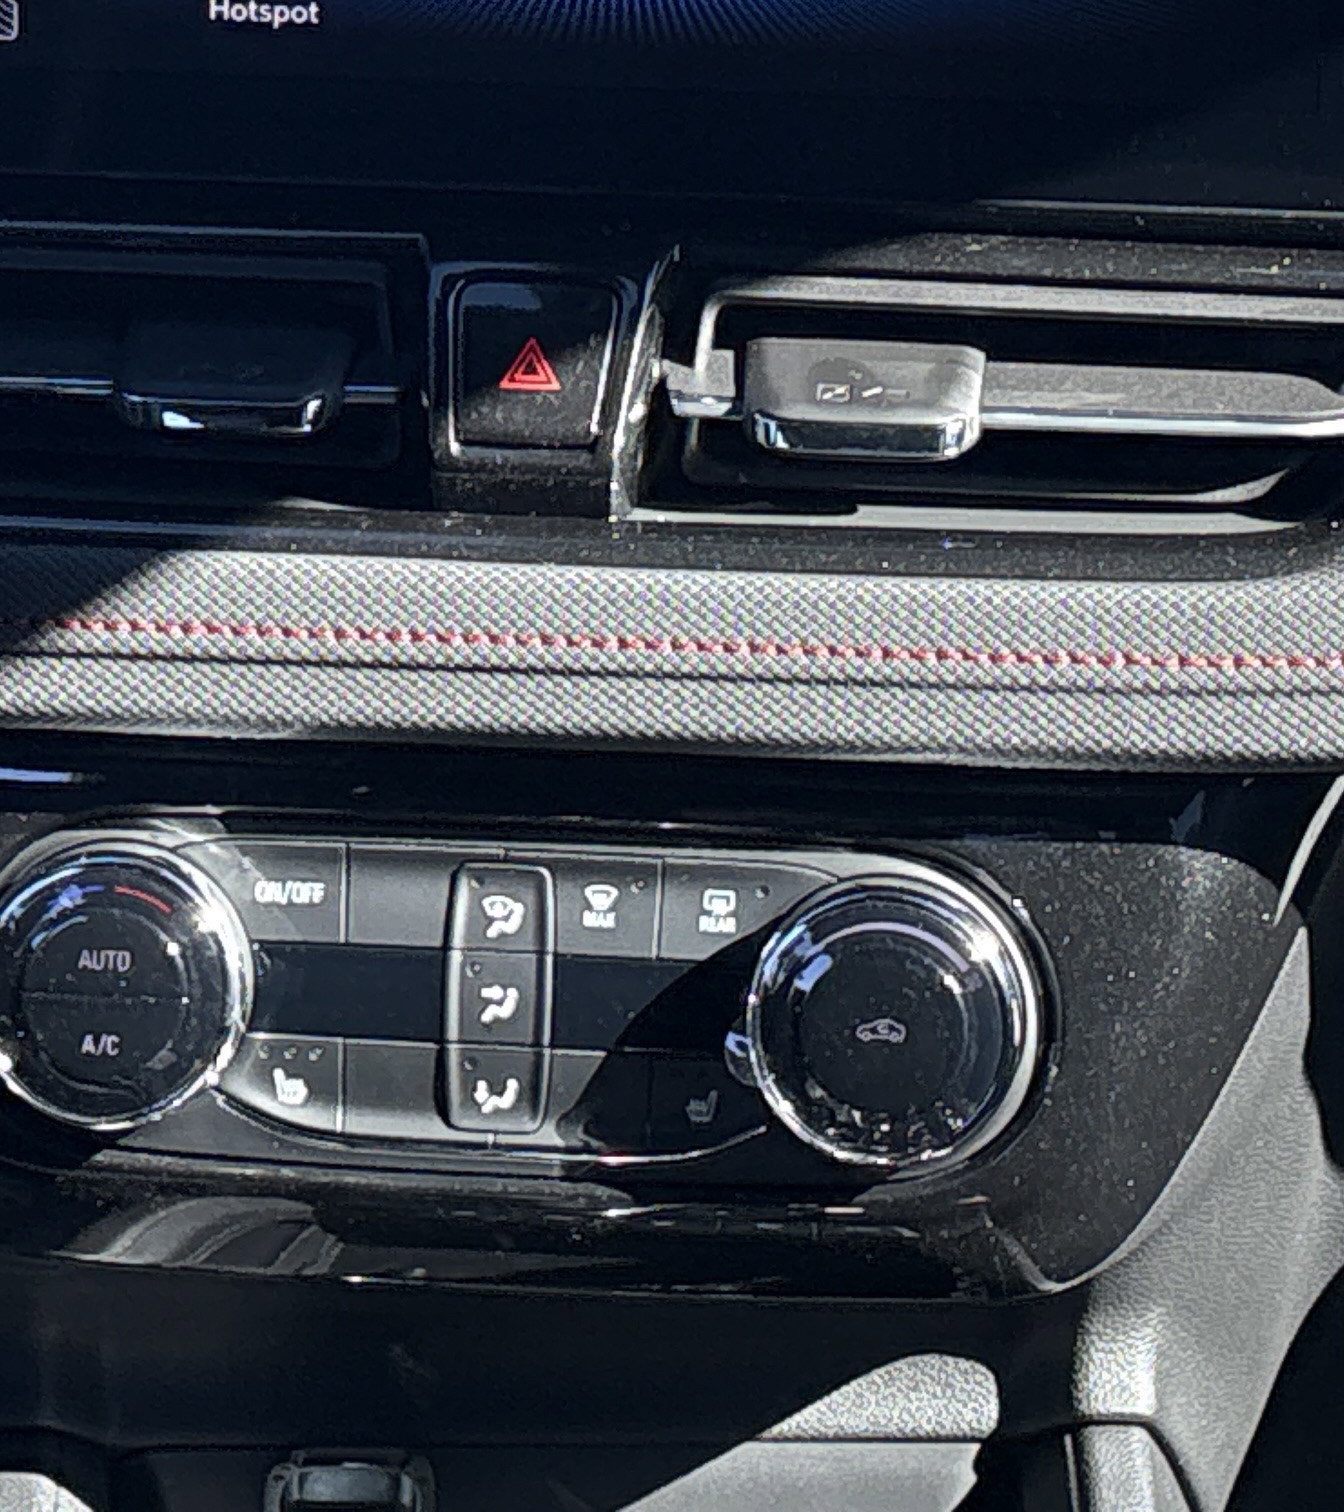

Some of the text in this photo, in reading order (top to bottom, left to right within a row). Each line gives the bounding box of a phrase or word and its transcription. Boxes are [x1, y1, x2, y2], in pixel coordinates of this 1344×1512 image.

[254, 880, 325, 905] ON/OFF
[698, 915, 737, 933] REAR
[77, 950, 133, 972] AUTO
[81, 1034, 120, 1057] A/C
